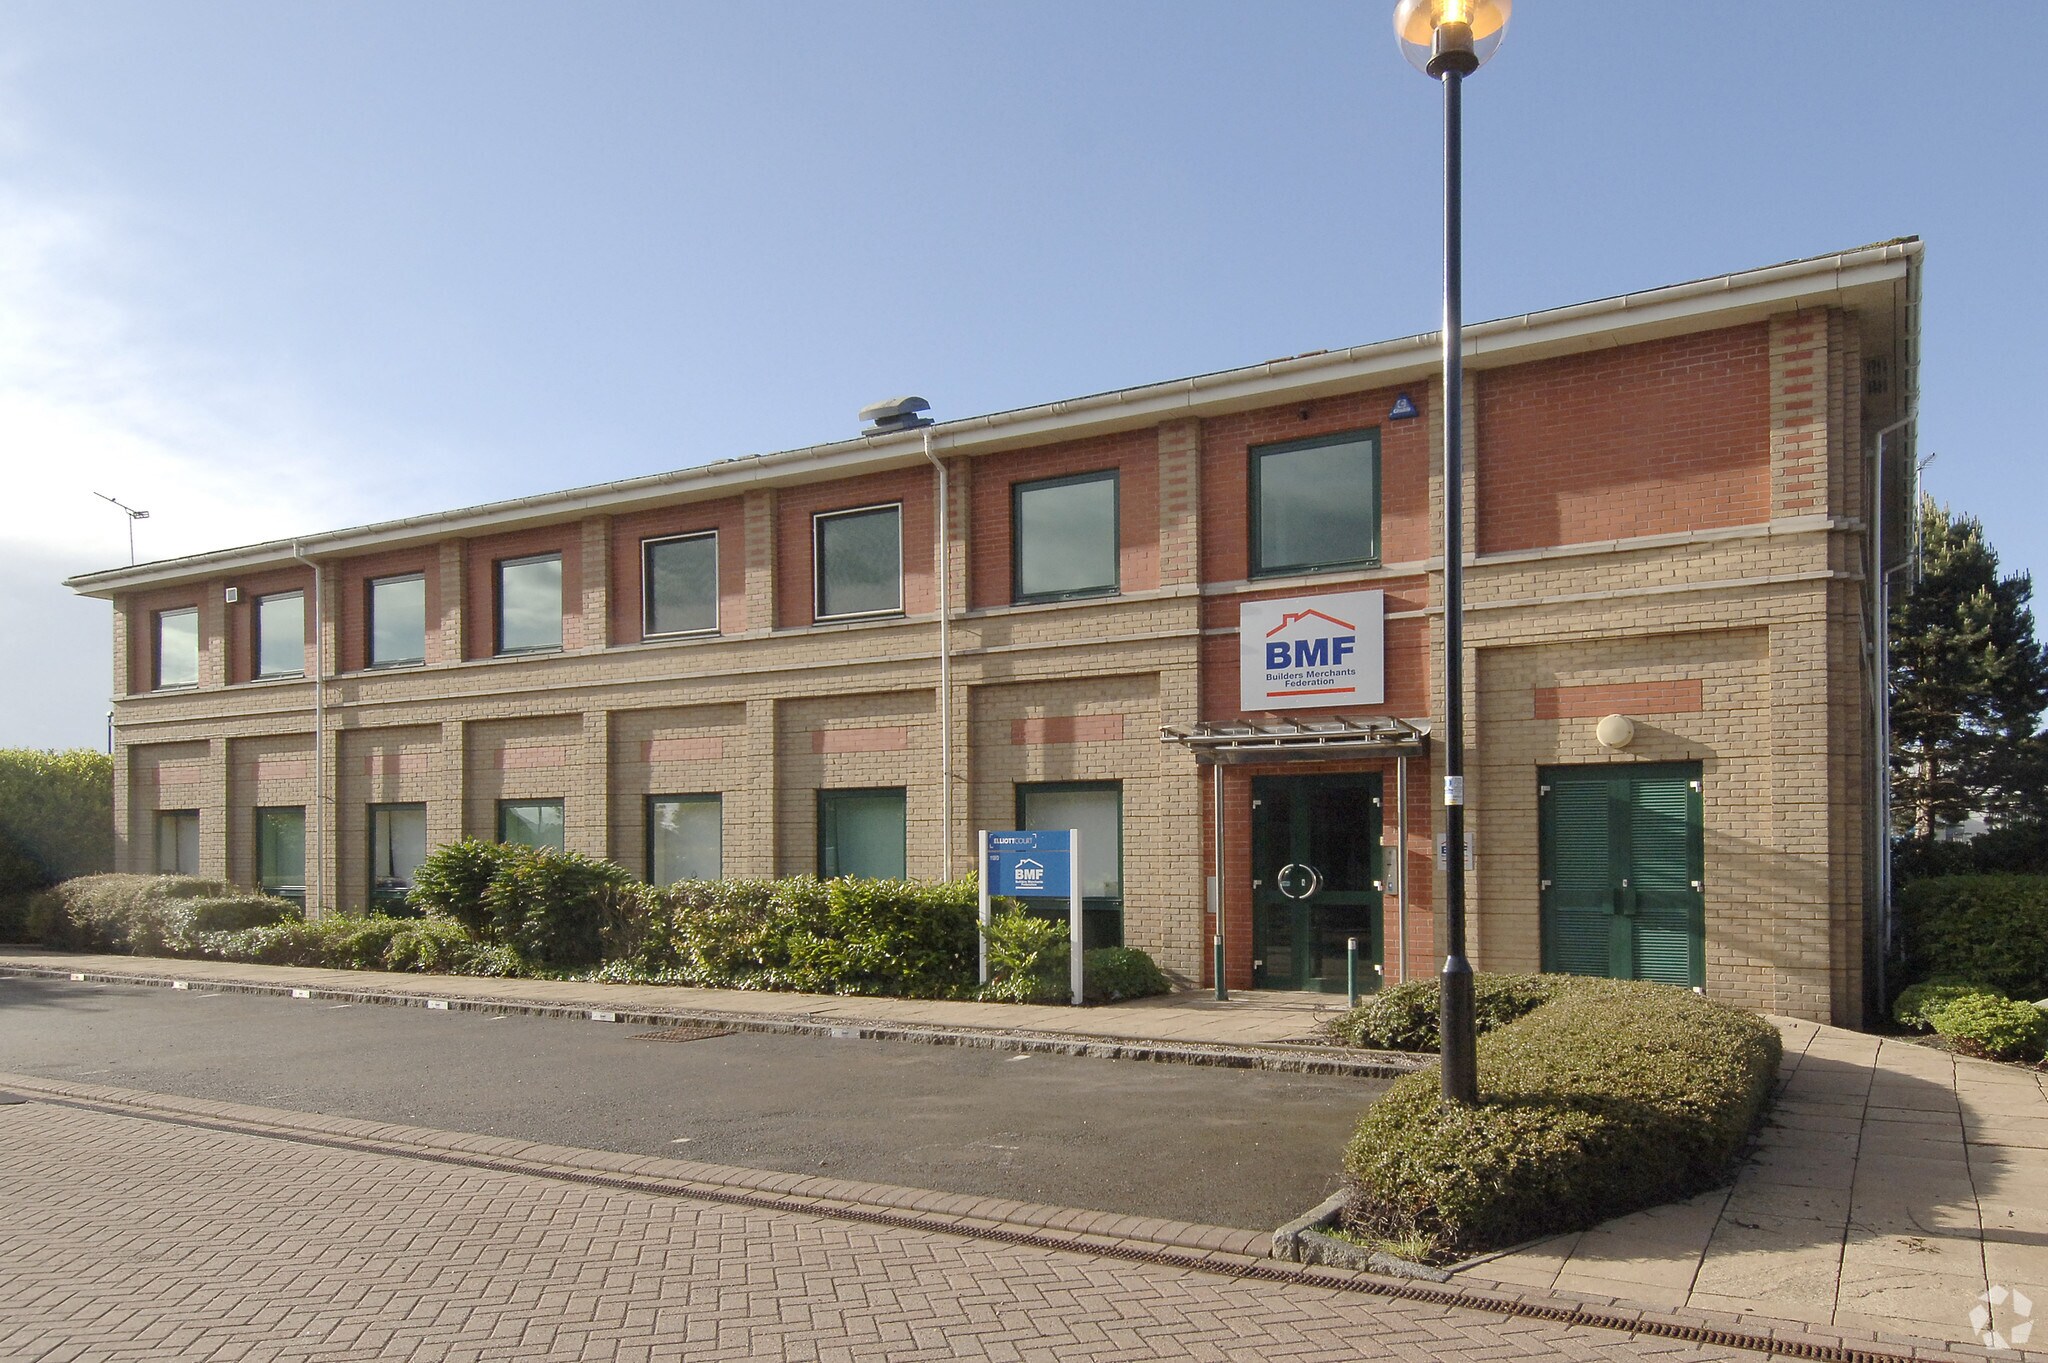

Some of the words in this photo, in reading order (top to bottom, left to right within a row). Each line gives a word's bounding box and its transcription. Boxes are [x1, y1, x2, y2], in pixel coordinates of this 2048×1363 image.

[1266, 635, 1356, 670] BMF
[1266, 671, 1304, 681] Builders
[1306, 668, 1356, 679] Merchants
[1285, 677, 1335, 688] Federation
[1015, 869, 1044, 880] BMF
